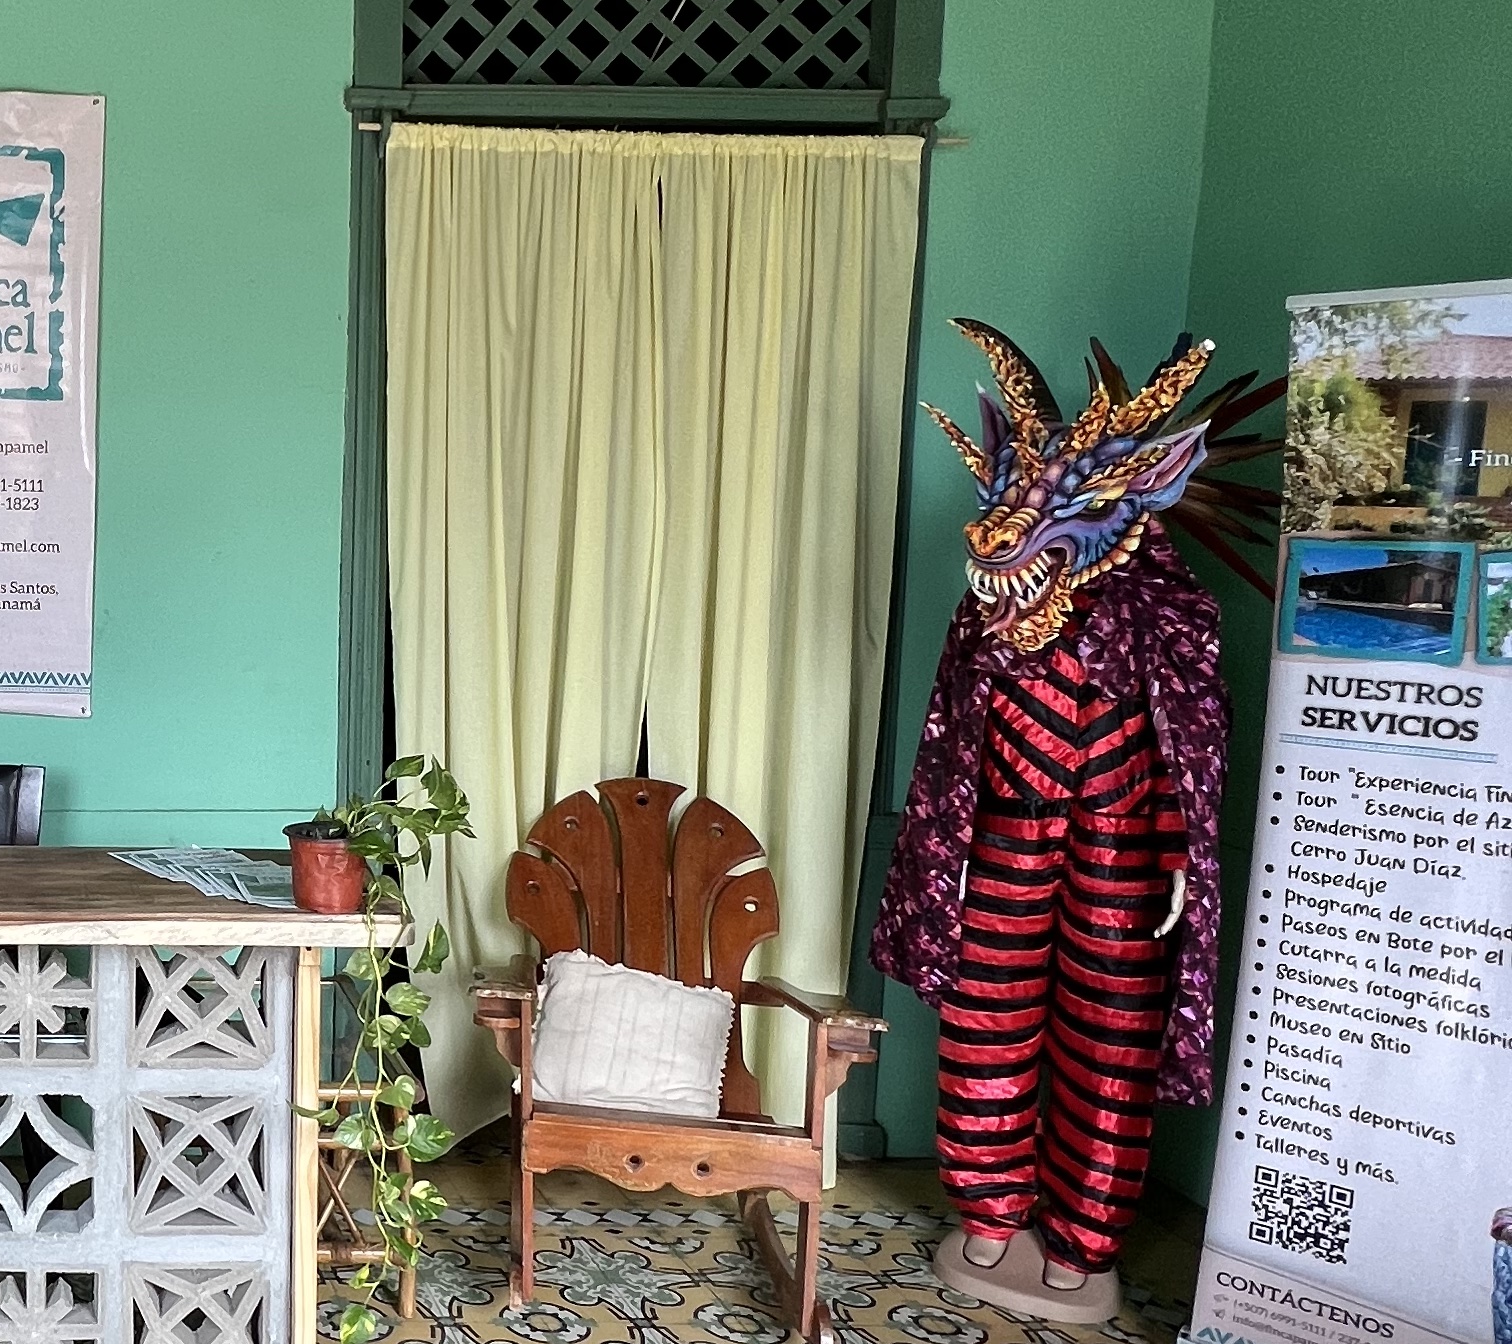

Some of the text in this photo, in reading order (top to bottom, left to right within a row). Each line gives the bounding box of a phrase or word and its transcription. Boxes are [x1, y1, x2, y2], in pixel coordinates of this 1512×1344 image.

[1469, 449, 1512, 467] Fin
[1305, 674, 1484, 708] NUESTROS
[1300, 706, 1479, 742] SERVICIOS
[1299, 766, 1340, 783] Tour
[1295, 791, 1337, 808] Tour
[1453, 808, 1478, 827] de
[1293, 815, 1406, 843] Senderismo
[1413, 833, 1449, 849] por
[1456, 837, 1475, 854] el
[1290, 841, 1346, 862] Cerro
[1354, 849, 1406, 870] Juan
[1288, 864, 1387, 897] Hospedaje
[1285, 888, 1381, 920] Programa
[1389, 905, 1413, 923] de
[1282, 913, 1503, 966] Paseos en Bote por el
[1279, 940, 1481, 992] Cutarra a la medida
[1276, 963, 1490, 1018] Sesiones fotográficas
[1273, 986, 1428, 1033] Presentaciones
[1270, 1011, 1411, 1055] Museo en Sitio
[1267, 1036, 1343, 1068] Pasadía
[1264, 1060, 1331, 1091] Piscina
[1258, 1110, 1333, 1141] Eventos
[1261, 1086, 1456, 1145] Canchas deportivas
[1255, 1133, 1330, 1166] Talleres
[1336, 1158, 1348, 1176] y
[1216, 1272, 1395, 1338] CONTÁCTENOS
